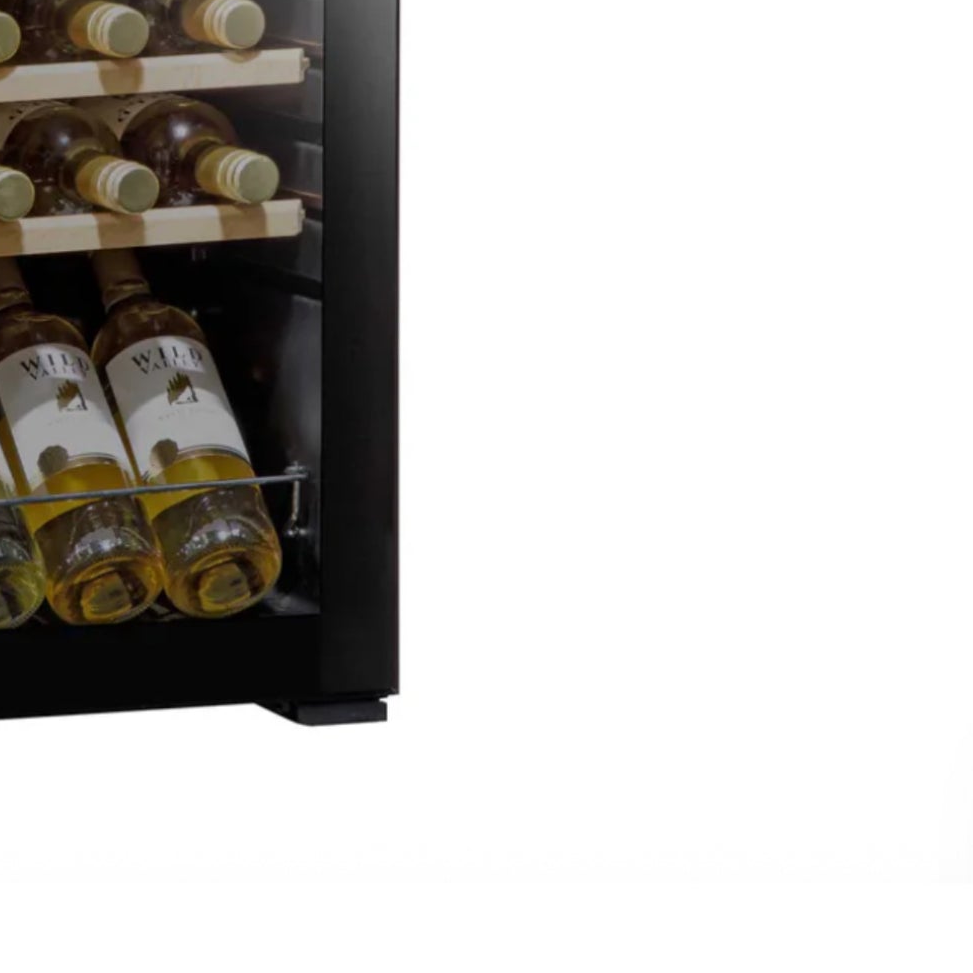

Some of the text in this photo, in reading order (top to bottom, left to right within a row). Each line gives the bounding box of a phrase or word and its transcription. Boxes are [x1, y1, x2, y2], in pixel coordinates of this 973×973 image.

[20, 353, 90, 373] WILD
[131, 346, 203, 367] WILD
[140, 357, 199, 375] VALLEY
